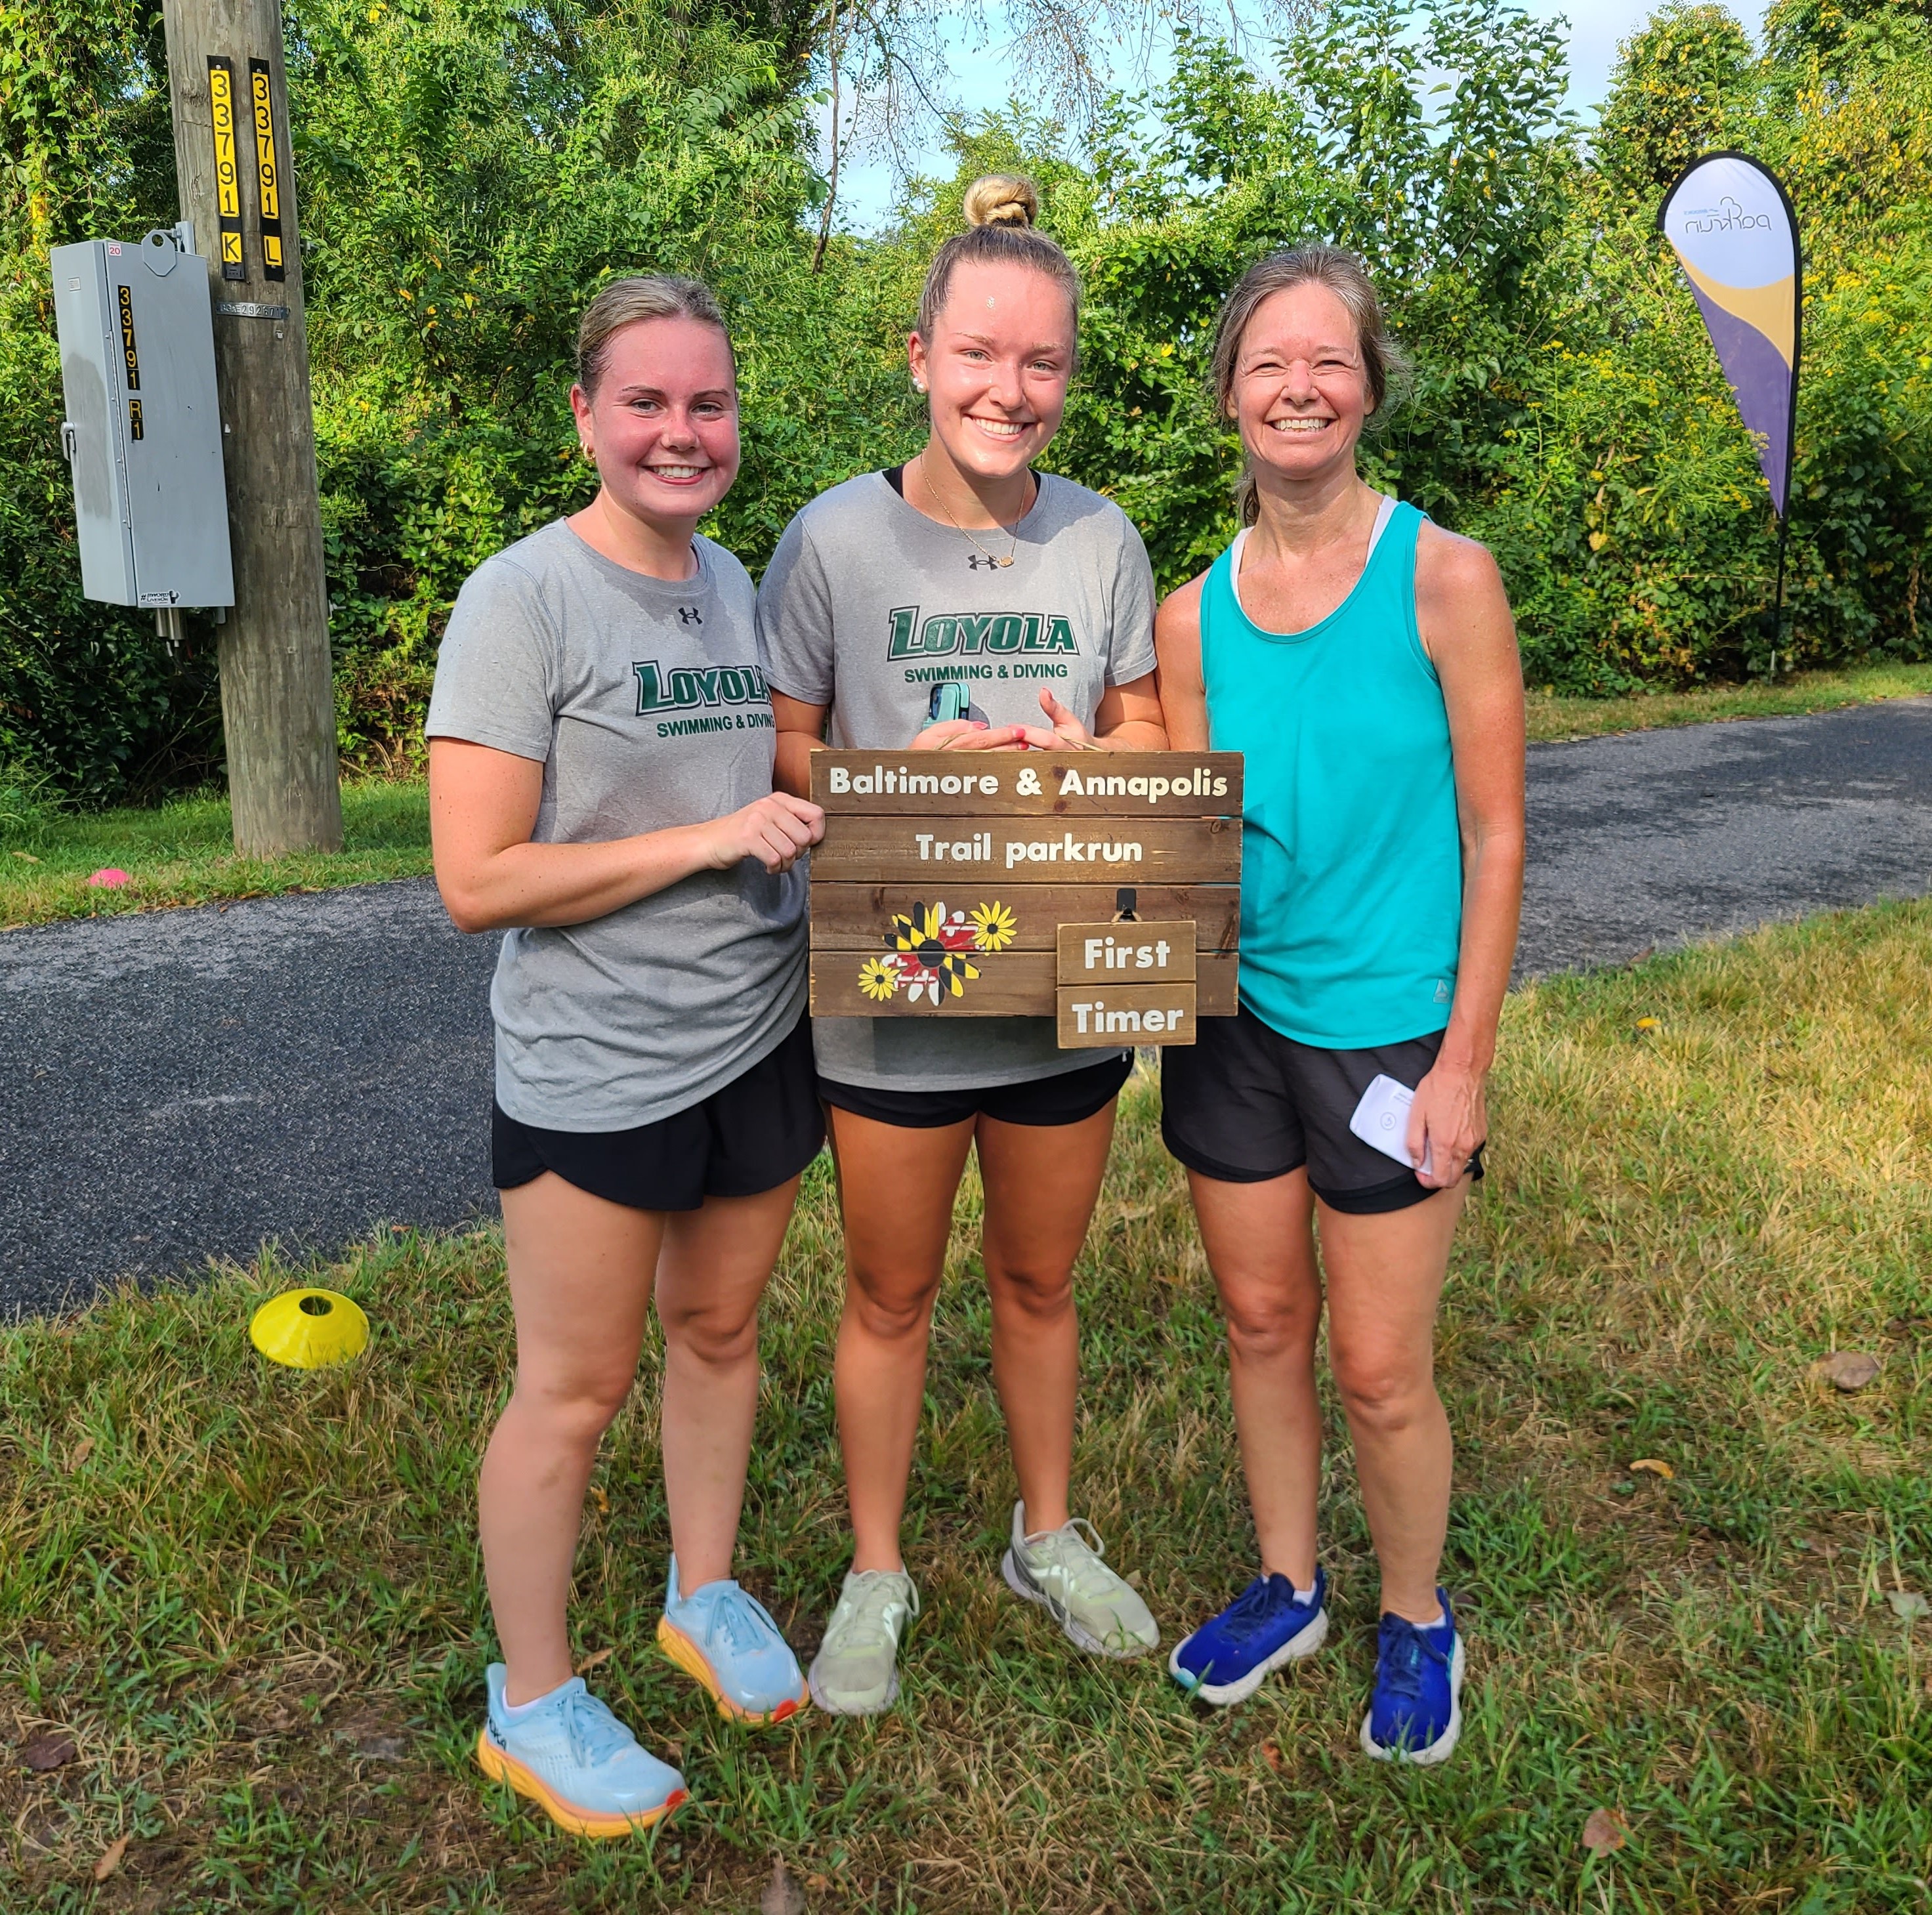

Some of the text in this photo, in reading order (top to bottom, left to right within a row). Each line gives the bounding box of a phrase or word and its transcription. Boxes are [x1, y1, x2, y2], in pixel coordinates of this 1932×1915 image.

[213, 73, 240, 260] 33791 K
[254, 76, 280, 263] 33791 L
[120, 287, 137, 389] 33791
[887, 605, 1080, 662] LOYOLA
[904, 664, 1068, 683] SWIMMING & DIVING
[657, 716, 733, 738] SWIMMING
[736, 715, 746, 729] &
[830, 765, 1228, 804] Baltimore & Annapolis
[915, 833, 1143, 869] Trail parkrun
[1085, 936, 1171, 969] First
[1072, 1001, 1184, 1034] Timer
